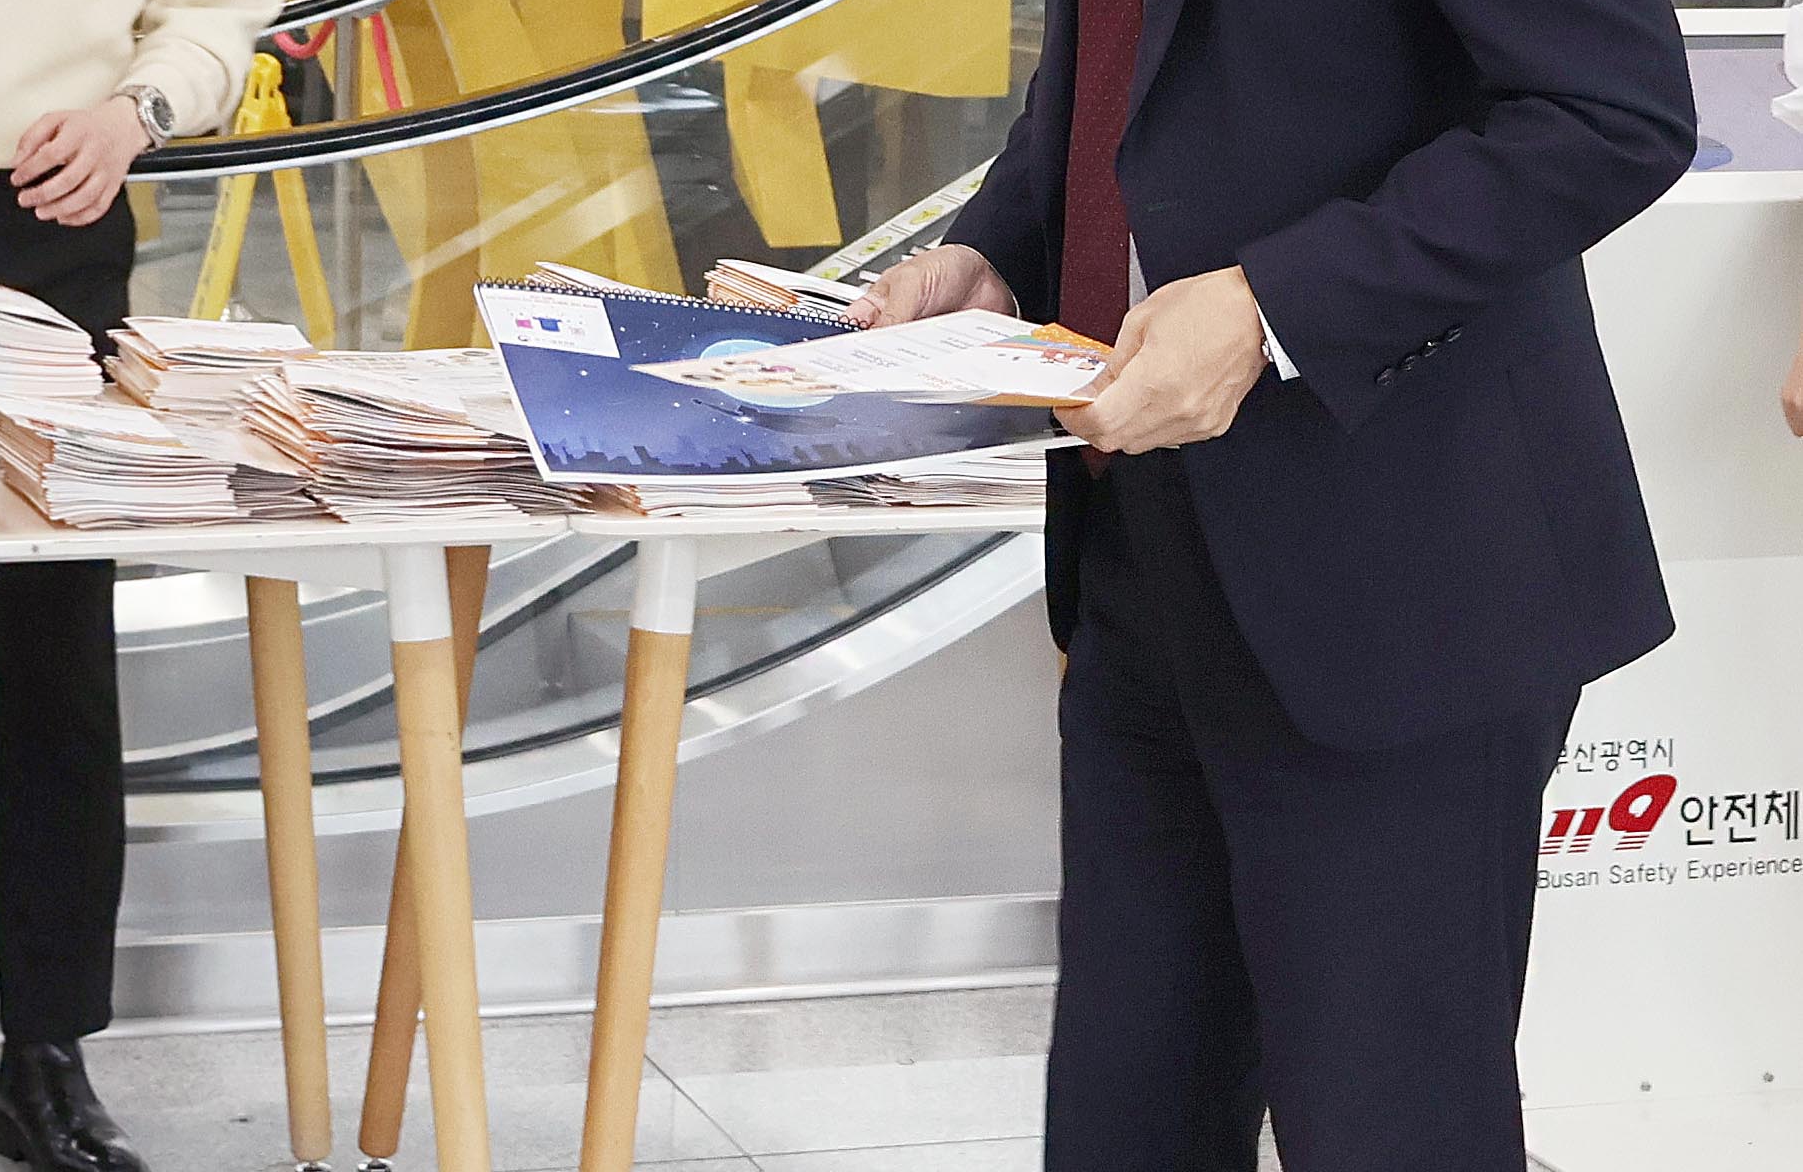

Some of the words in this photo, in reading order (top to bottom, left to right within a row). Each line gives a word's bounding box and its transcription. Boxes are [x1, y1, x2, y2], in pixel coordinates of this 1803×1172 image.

[1538, 774, 1677, 855] 119
[1680, 789, 1800, 846] 안전체
[1537, 869, 1599, 890] Busan
[1609, 861, 1677, 886] Safety
[1687, 855, 1803, 881] Experience
